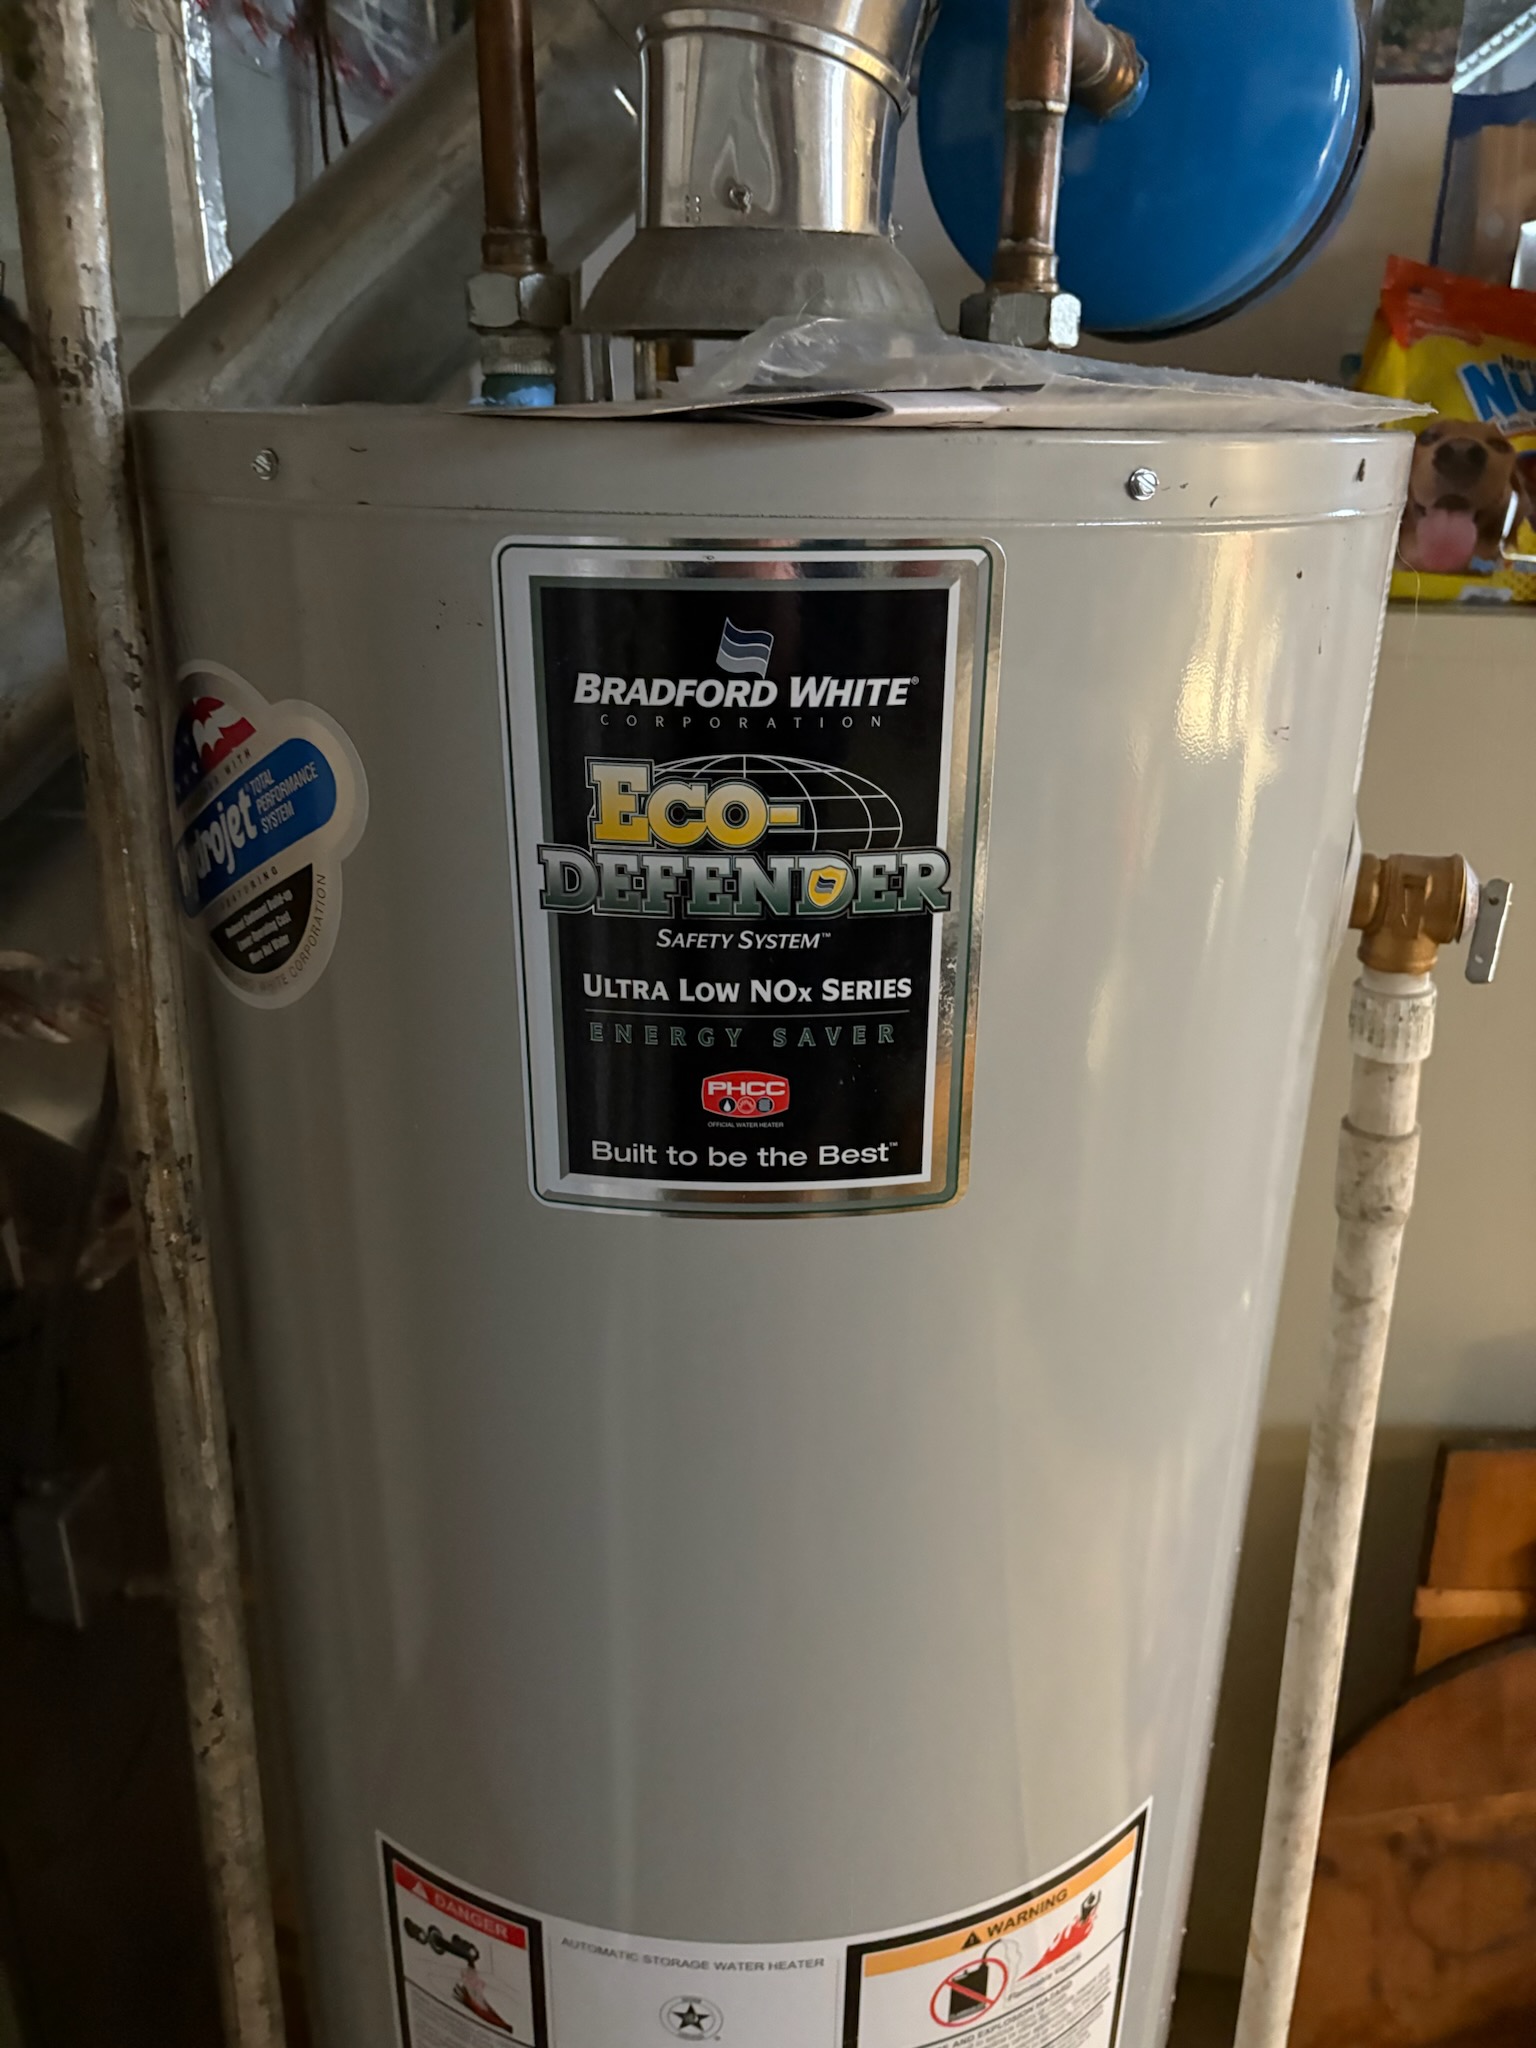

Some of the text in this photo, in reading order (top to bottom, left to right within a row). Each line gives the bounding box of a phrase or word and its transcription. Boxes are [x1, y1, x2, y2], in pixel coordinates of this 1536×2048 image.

[573, 673, 778, 708] BRADFORD
[600, 714, 882, 729] CORPORATION
[249, 768, 276, 795] TOTAL
[256, 761, 319, 815] PERFORMANCE
[261, 801, 295, 834] SYSTEM
[537, 844, 951, 918] DEFENDER
[656, 928, 734, 950] SAFETY
[582, 973, 669, 1000] ULTRA
[679, 977, 740, 1003] LOW
[821, 977, 912, 1001] SERIES
[590, 1022, 895, 1048] ENERGY SAVER
[707, 1081, 786, 1096] PHCC
[736, 1121, 758, 1129] WATER
[592, 1140, 658, 1166] Built
[666, 1144, 698, 1167] to
[708, 1143, 748, 1168] be
[756, 1142, 808, 1167] the
[433, 1893, 510, 1939] DANGER
[986, 1887, 1069, 1939] WARNING
[561, 1937, 825, 1972] AUTOMATIC STORAGE WATER HEATER
